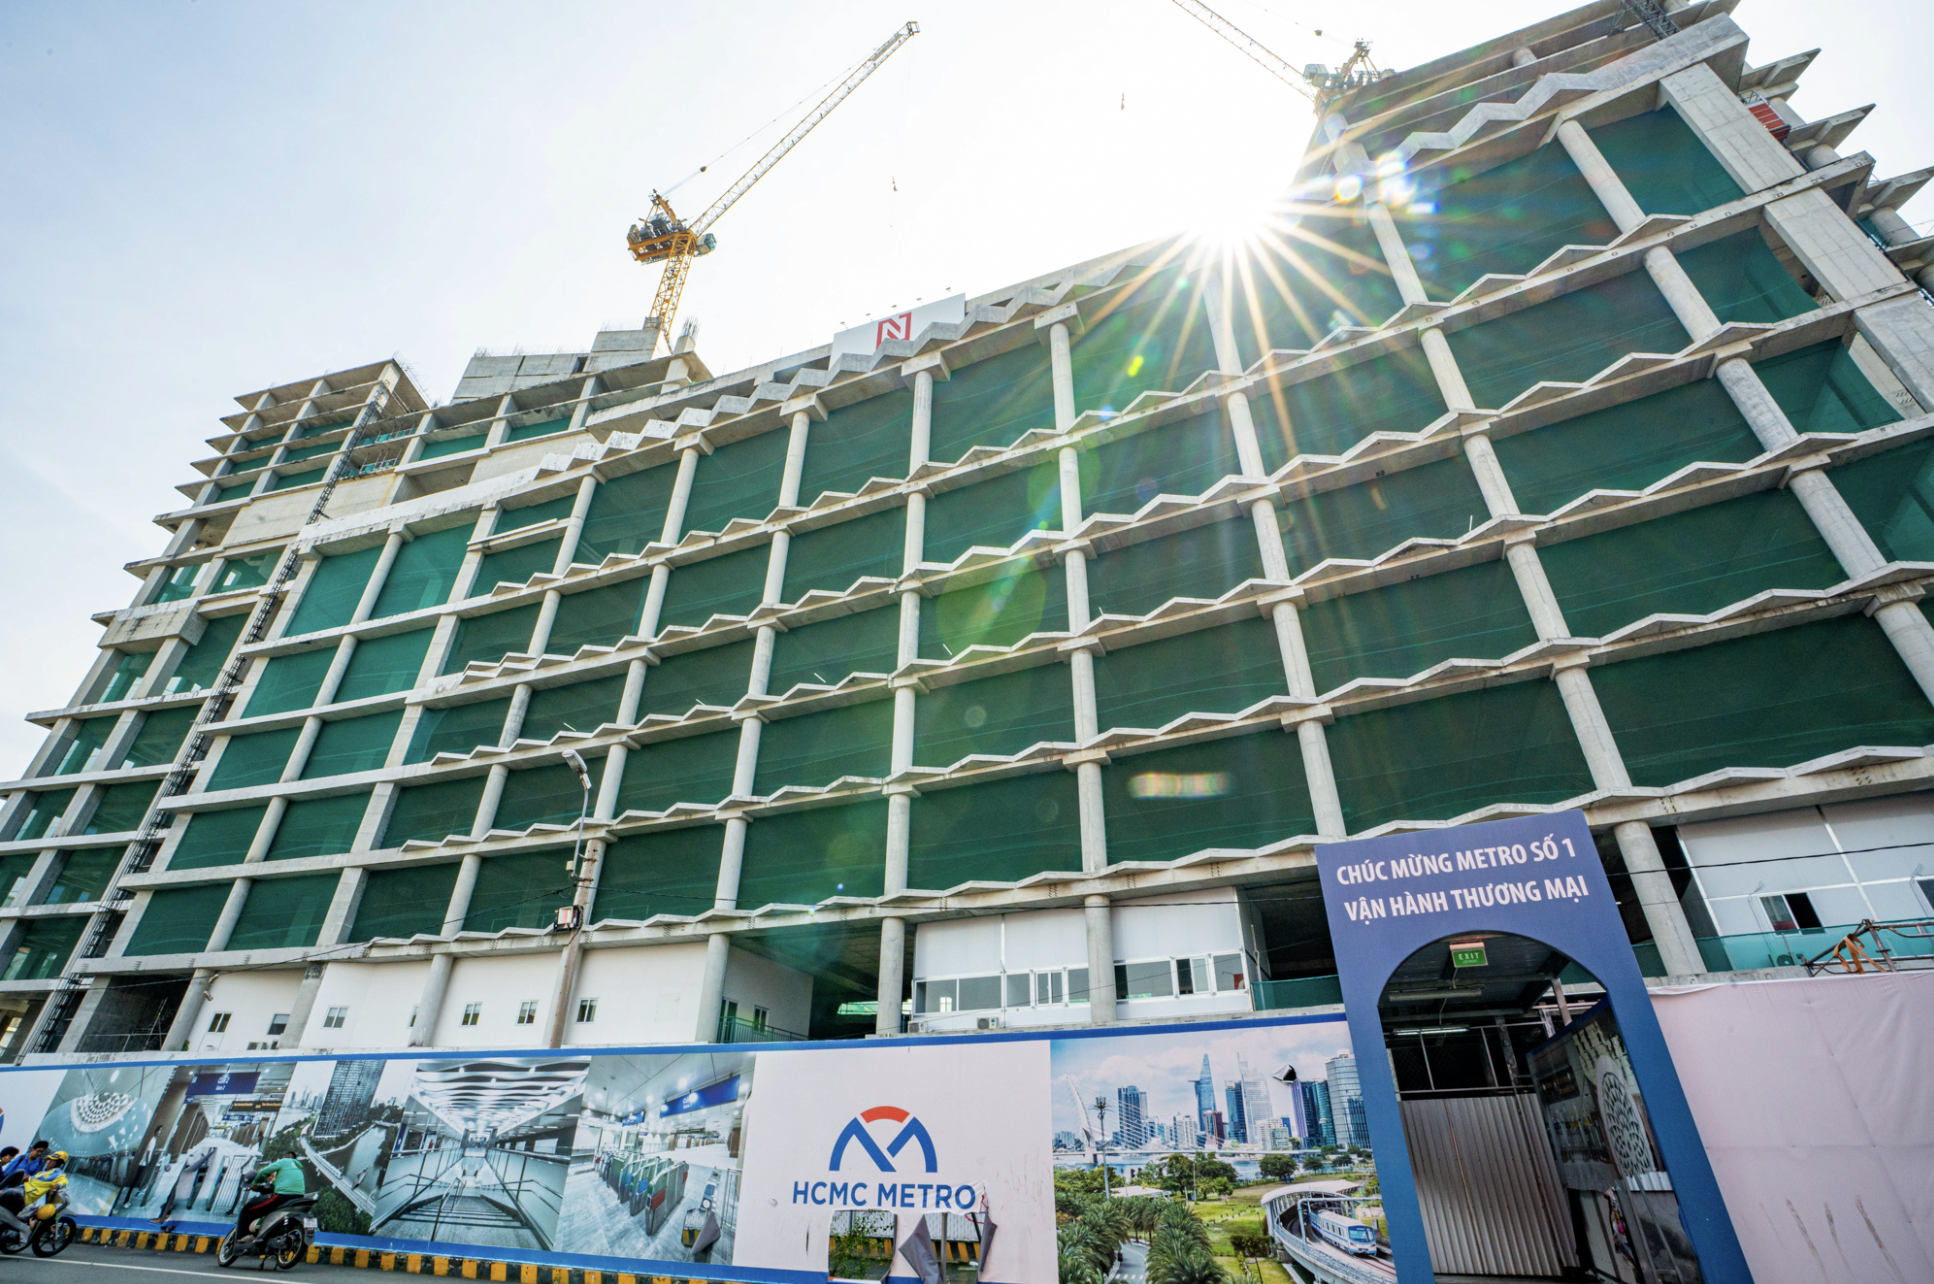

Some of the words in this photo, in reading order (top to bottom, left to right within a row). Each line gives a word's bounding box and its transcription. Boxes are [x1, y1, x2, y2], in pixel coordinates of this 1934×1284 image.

[1337, 860, 1388, 885] CHÚC
[1391, 854, 1453, 879] MỪNG
[1456, 844, 1527, 871] METRO
[1530, 834, 1559, 861] SỐ
[1562, 838, 1576, 857] 1
[1344, 897, 1386, 925] VẬN
[1389, 891, 1448, 916] HÀNH
[1450, 881, 1541, 909] THƯƠNG
[1544, 875, 1589, 903] MẠI
[1458, 952, 1479, 960] EXIT
[793, 1181, 867, 1206] HCMC
[878, 1183, 976, 1209] METRO
